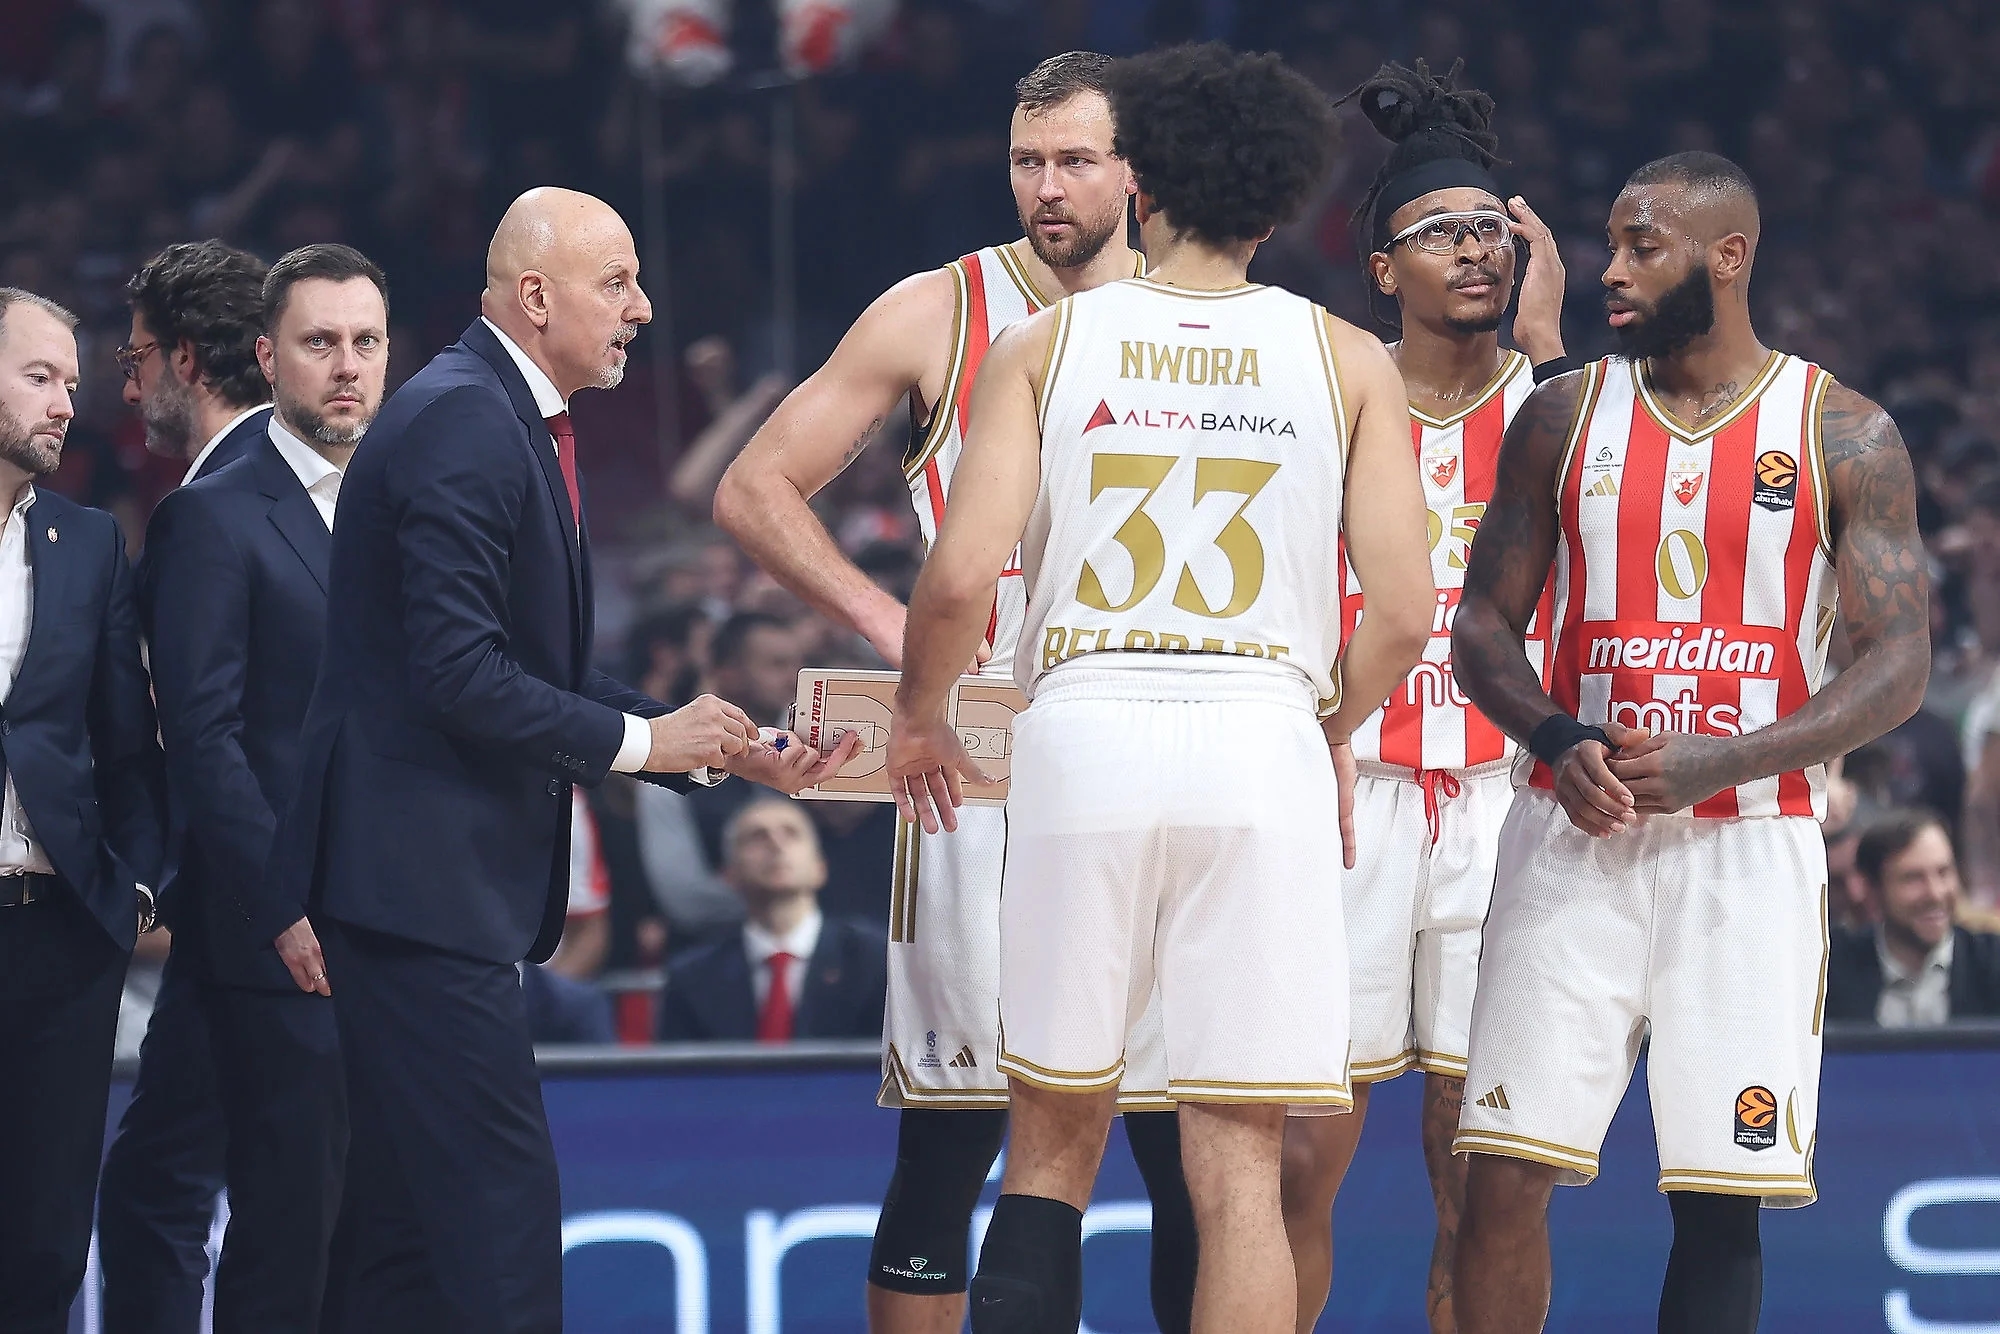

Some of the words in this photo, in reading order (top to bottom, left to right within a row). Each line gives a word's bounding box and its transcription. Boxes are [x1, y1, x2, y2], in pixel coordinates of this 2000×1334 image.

[1120, 341, 1261, 387] NWORA
[1075, 453, 1282, 619] 33
[1656, 530, 1707, 599] 0
[1588, 627, 1775, 673] meridian
[812, 680, 823, 723] ZVEZDA
[1611, 692, 1740, 738] mts
[1736, 1135, 1751, 1143] abu
[882, 1265, 946, 1280] GAMEPATCH
